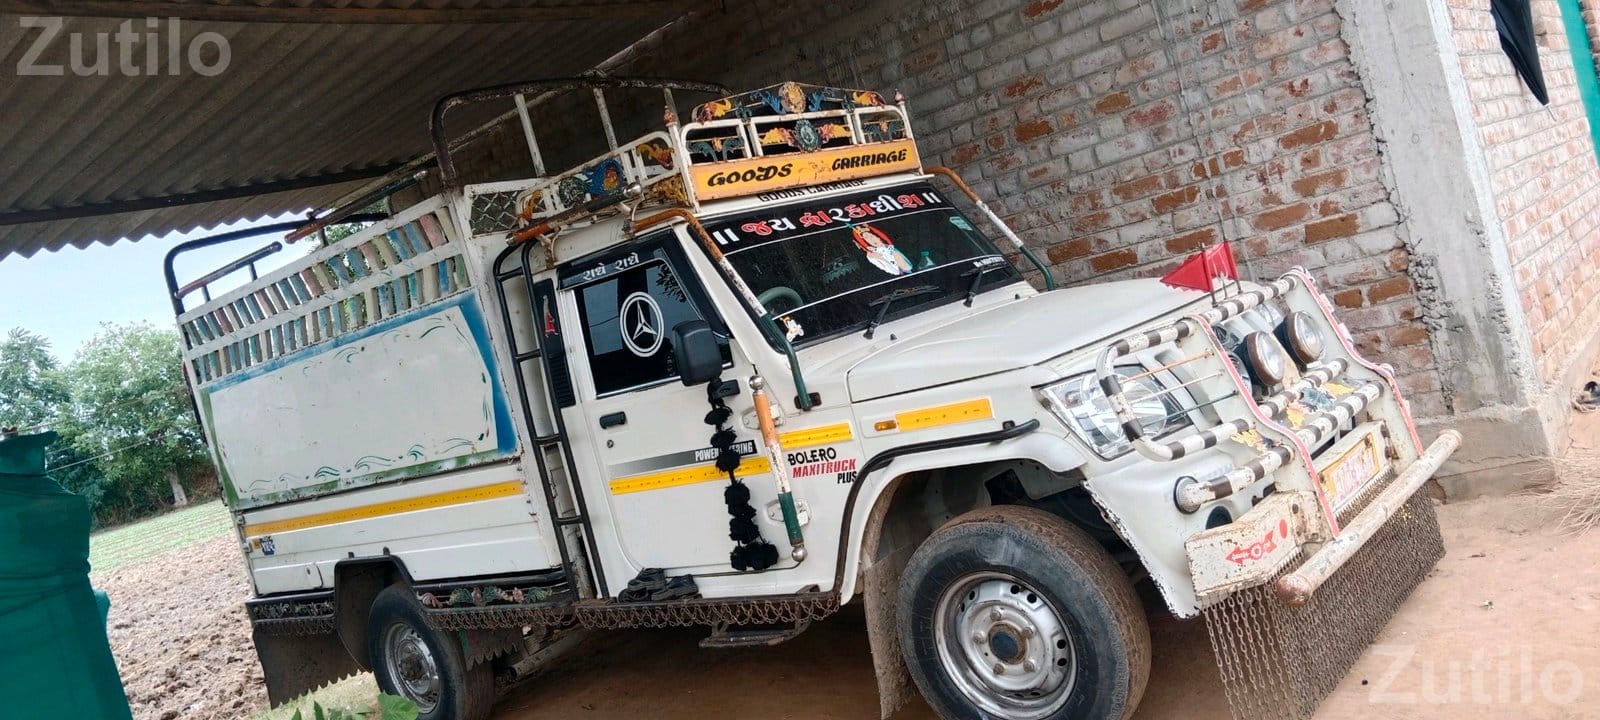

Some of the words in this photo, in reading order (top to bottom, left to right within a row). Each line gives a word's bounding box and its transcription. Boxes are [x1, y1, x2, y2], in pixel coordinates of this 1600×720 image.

[707, 163, 793, 187] GOODS
[741, 216, 797, 237] જય
[582, 262, 607, 281] રાધે
[614, 251, 640, 272] રાધે
[787, 446, 837, 466] BOLERO
[792, 459, 857, 479] MAXITRUCK
[837, 470, 857, 485] PLUS
